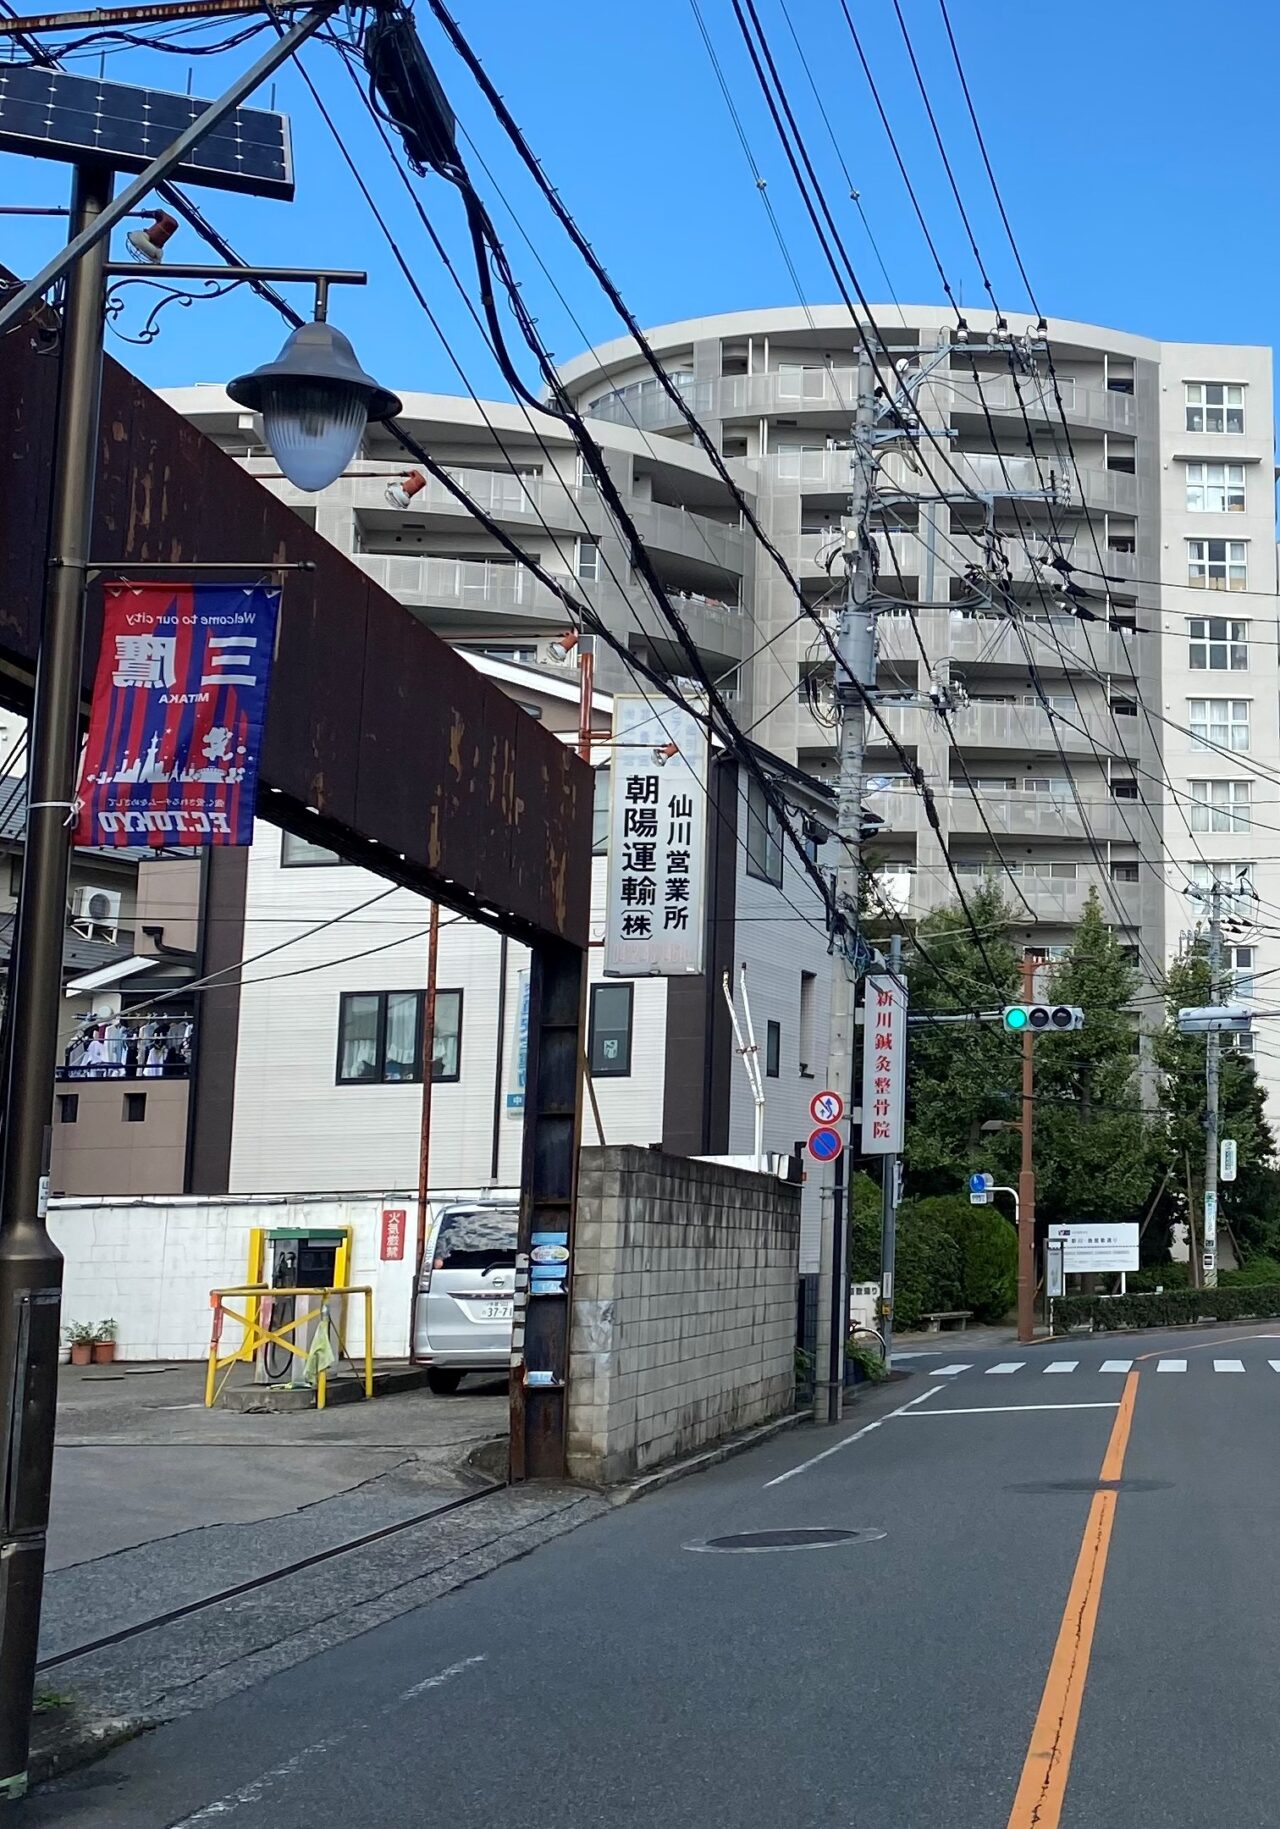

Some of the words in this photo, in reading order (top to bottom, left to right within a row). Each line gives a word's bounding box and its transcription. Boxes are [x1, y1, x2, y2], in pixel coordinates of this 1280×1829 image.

[663, 793, 693, 931] 仙川営業所
[872, 989, 893, 1139] 新川鍼灸整骨院
[387, 1212, 401, 1258] 火気厳禁
